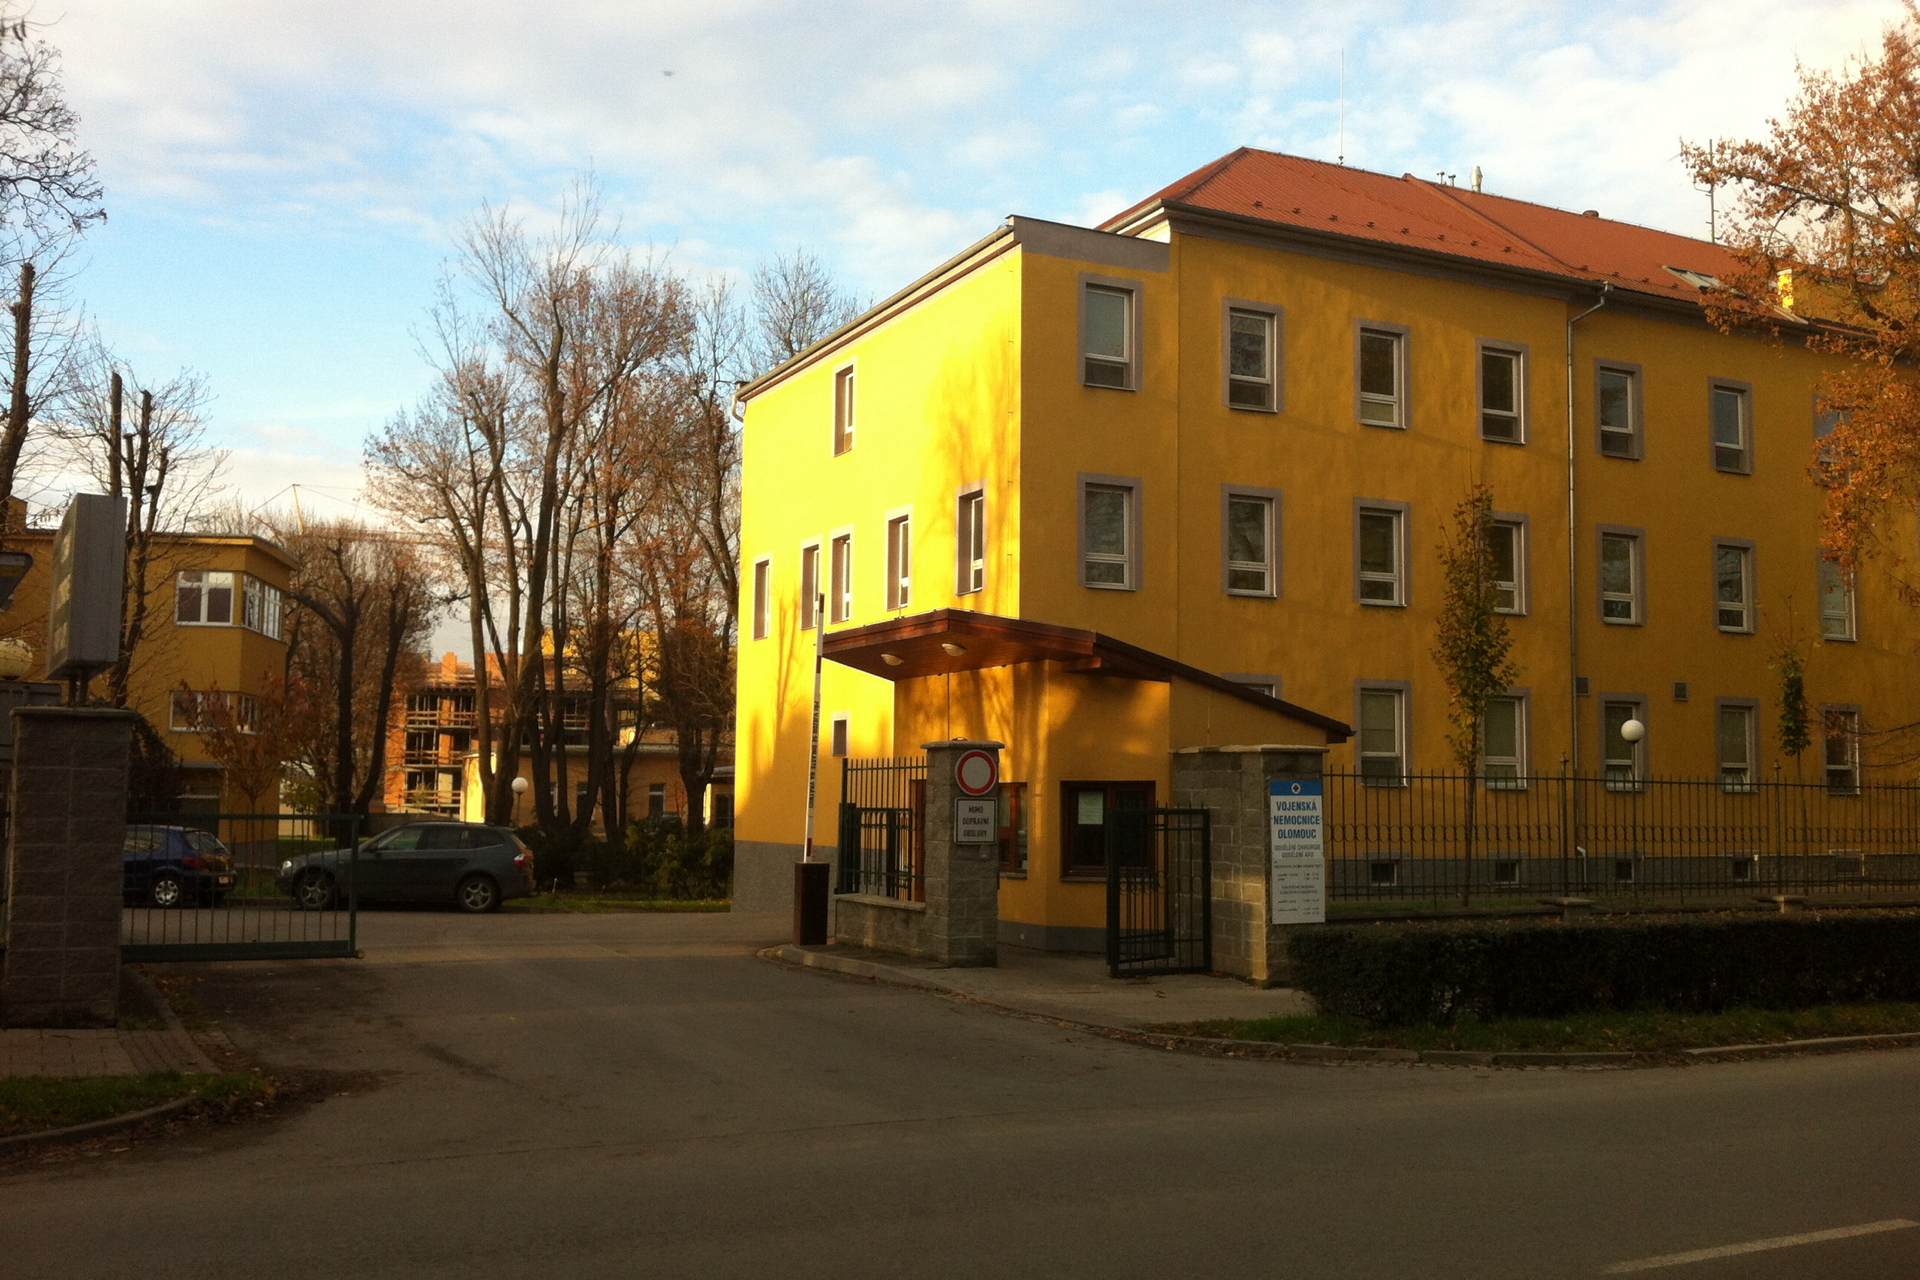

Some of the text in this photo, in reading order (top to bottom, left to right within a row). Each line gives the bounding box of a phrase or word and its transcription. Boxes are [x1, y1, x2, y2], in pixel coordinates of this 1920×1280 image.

[968, 805, 984, 813] MIMO
[1276, 799, 1317, 811] VOJENSKÁ
[962, 816, 990, 825] DOPRAVNÍ
[1273, 815, 1320, 825] NEMOCNICE
[963, 829, 988, 837] OBSLUHY
[1277, 829, 1317, 839] OLOMOUC
